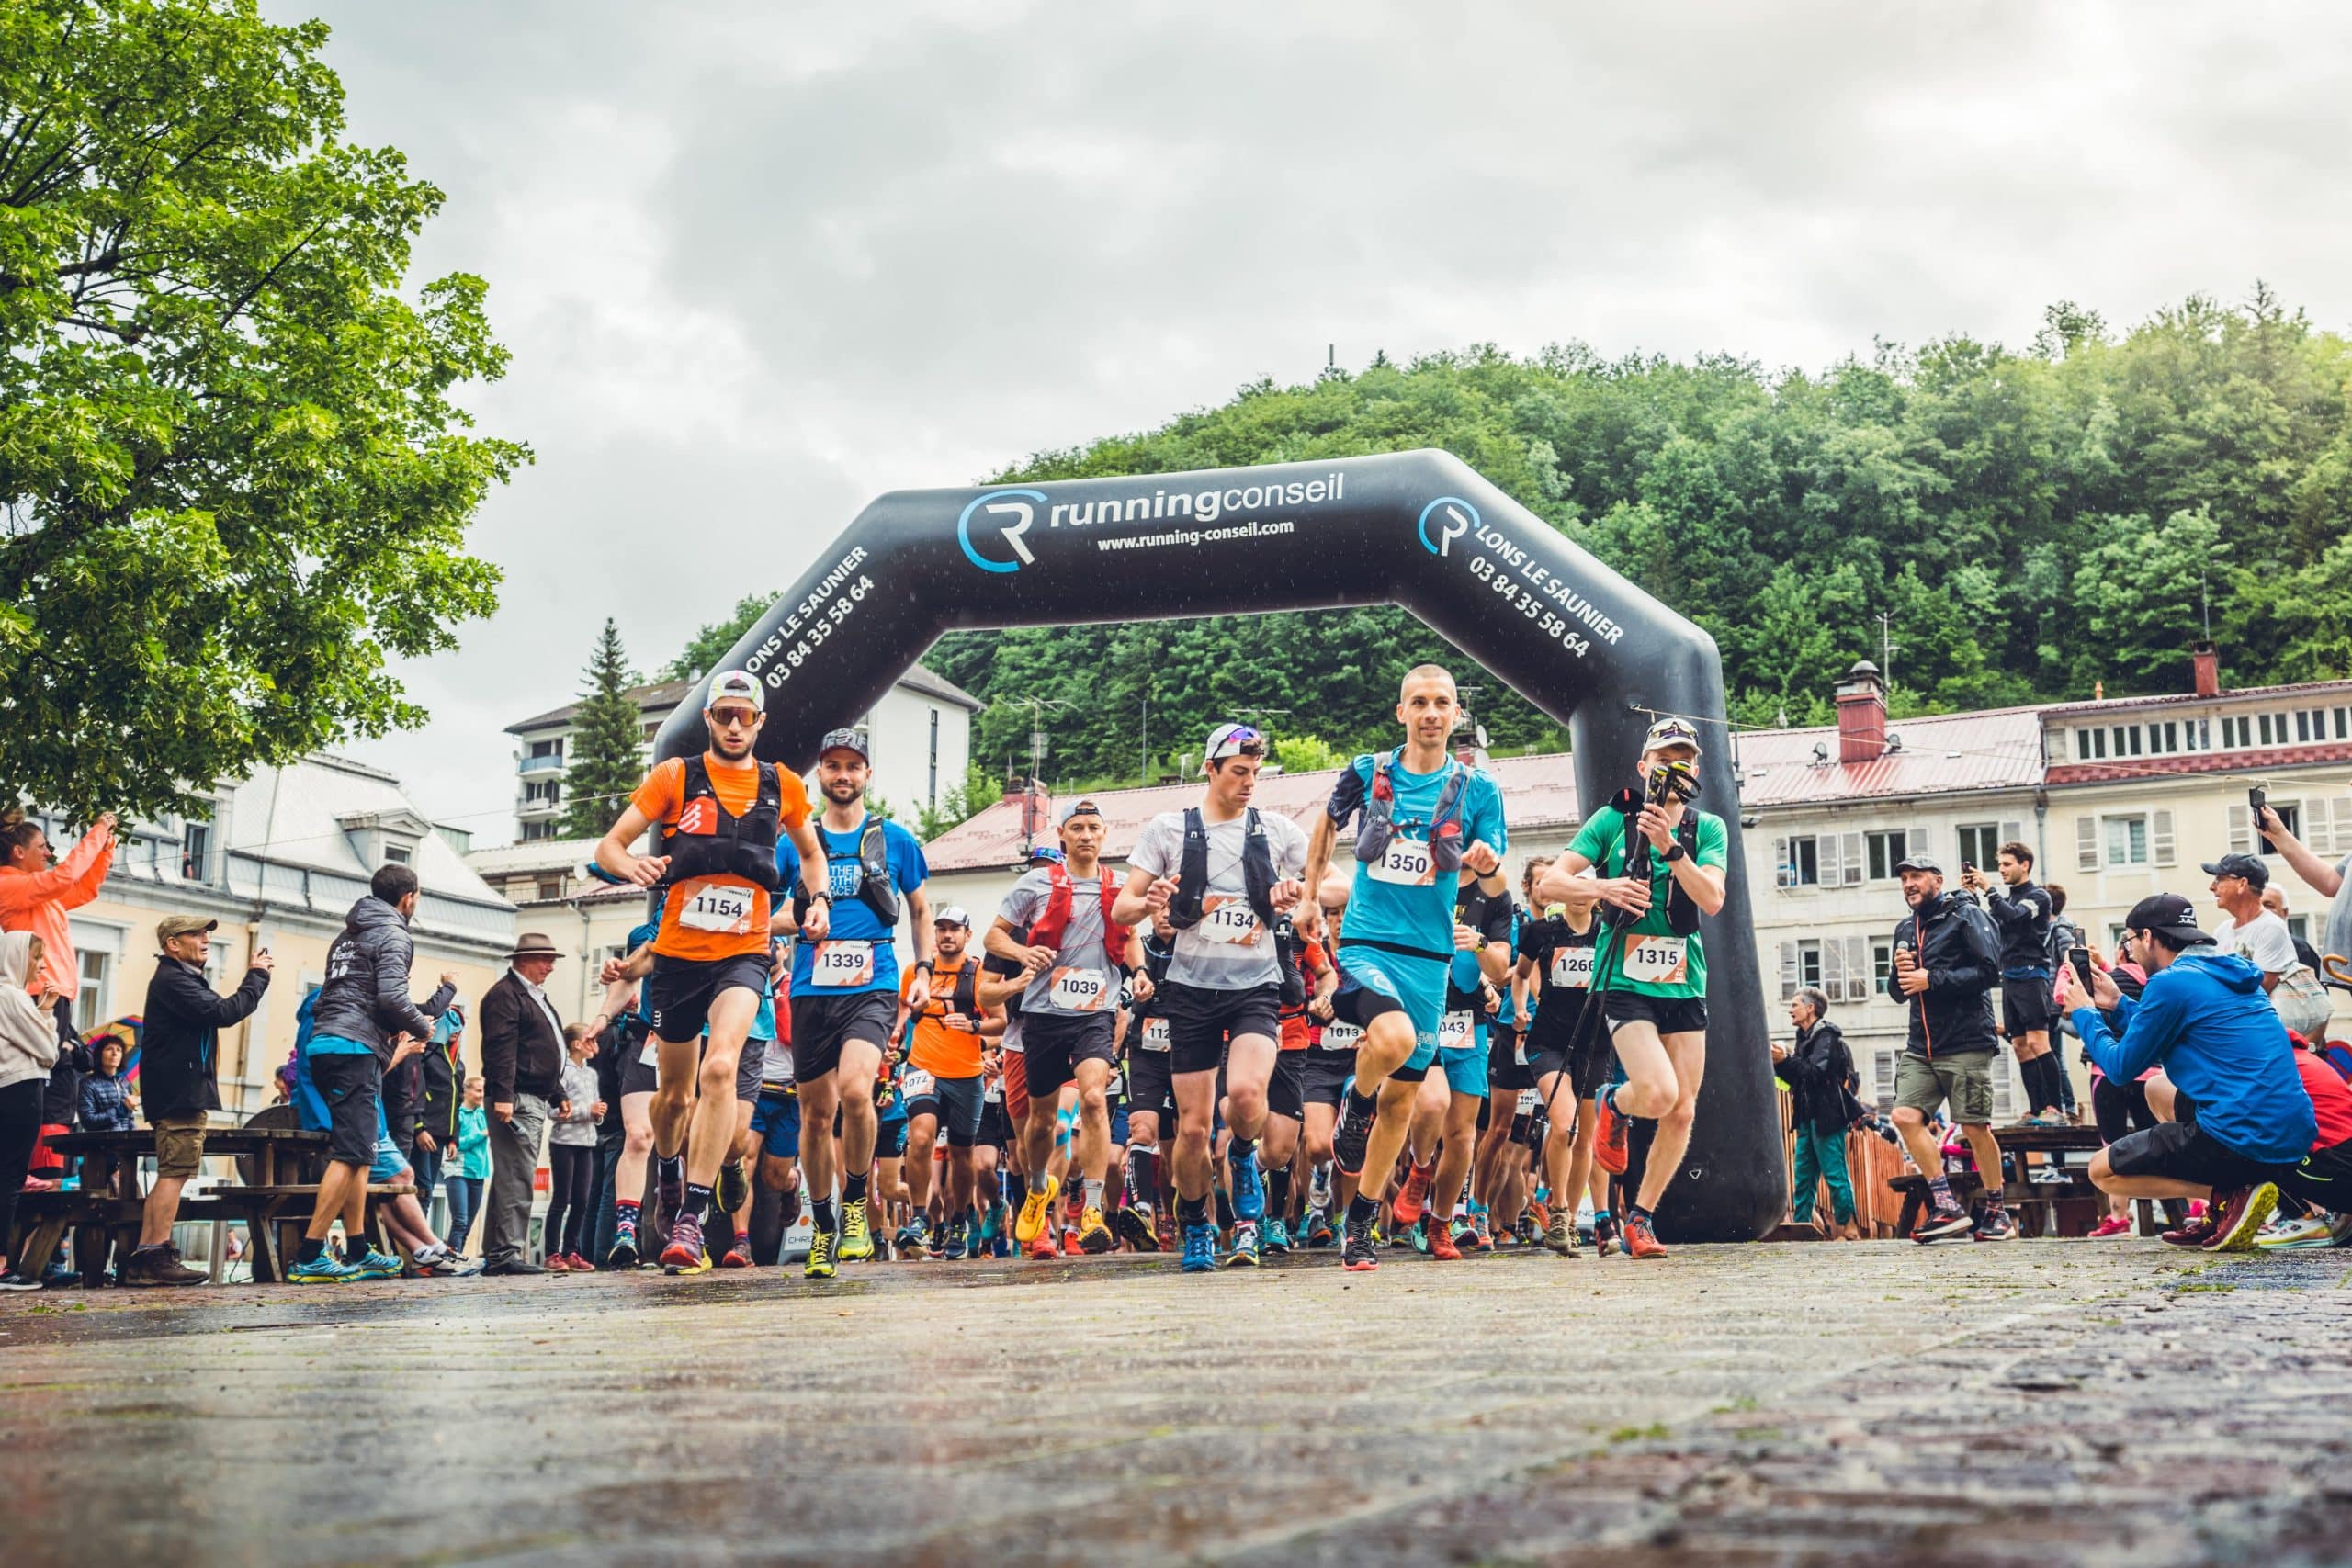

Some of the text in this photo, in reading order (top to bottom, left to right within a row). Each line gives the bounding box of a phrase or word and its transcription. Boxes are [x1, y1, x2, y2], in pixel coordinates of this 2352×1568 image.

[1050, 473, 1344, 528] runningconseil
[1097, 521, 1295, 551] www.running-conseil.com
[1476, 525, 1624, 645] LONS LE SAUNIER
[746, 546, 868, 672] ONS LE SAUNIER
[1469, 556, 1590, 658] 03 84 35 58 64
[766, 574, 875, 688] 03 84 35 58 64
[830, 864, 854, 875] THE
[1381, 852, 1427, 874] 1350
[830, 886, 851, 896] ACE
[696, 897, 742, 918] 1154
[1214, 910, 1254, 928] 1134
[823, 953, 864, 968] 1339
[1636, 948, 1678, 965] 1315
[1061, 979, 1099, 995] 1039
[1149, 1028, 1170, 1039] 112
[1329, 1026, 1359, 1037] 1013
[904, 1074, 928, 1089] 1072
